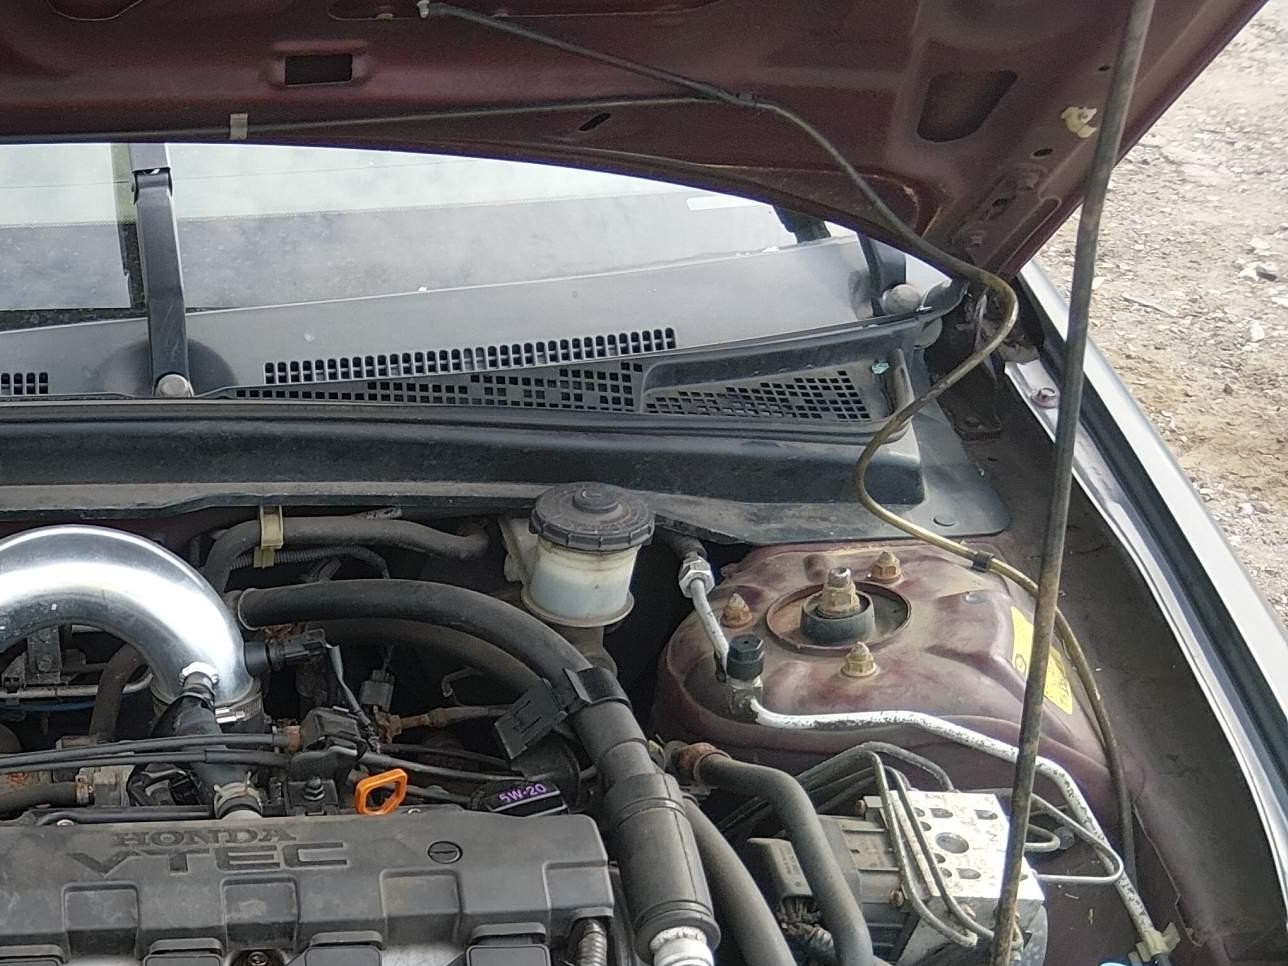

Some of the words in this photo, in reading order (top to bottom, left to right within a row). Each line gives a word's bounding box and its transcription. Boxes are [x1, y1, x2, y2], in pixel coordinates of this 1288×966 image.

[499, 783, 546, 803] 5W-20
[112, 827, 297, 847] HONDA
[70, 841, 349, 877] VTEC
